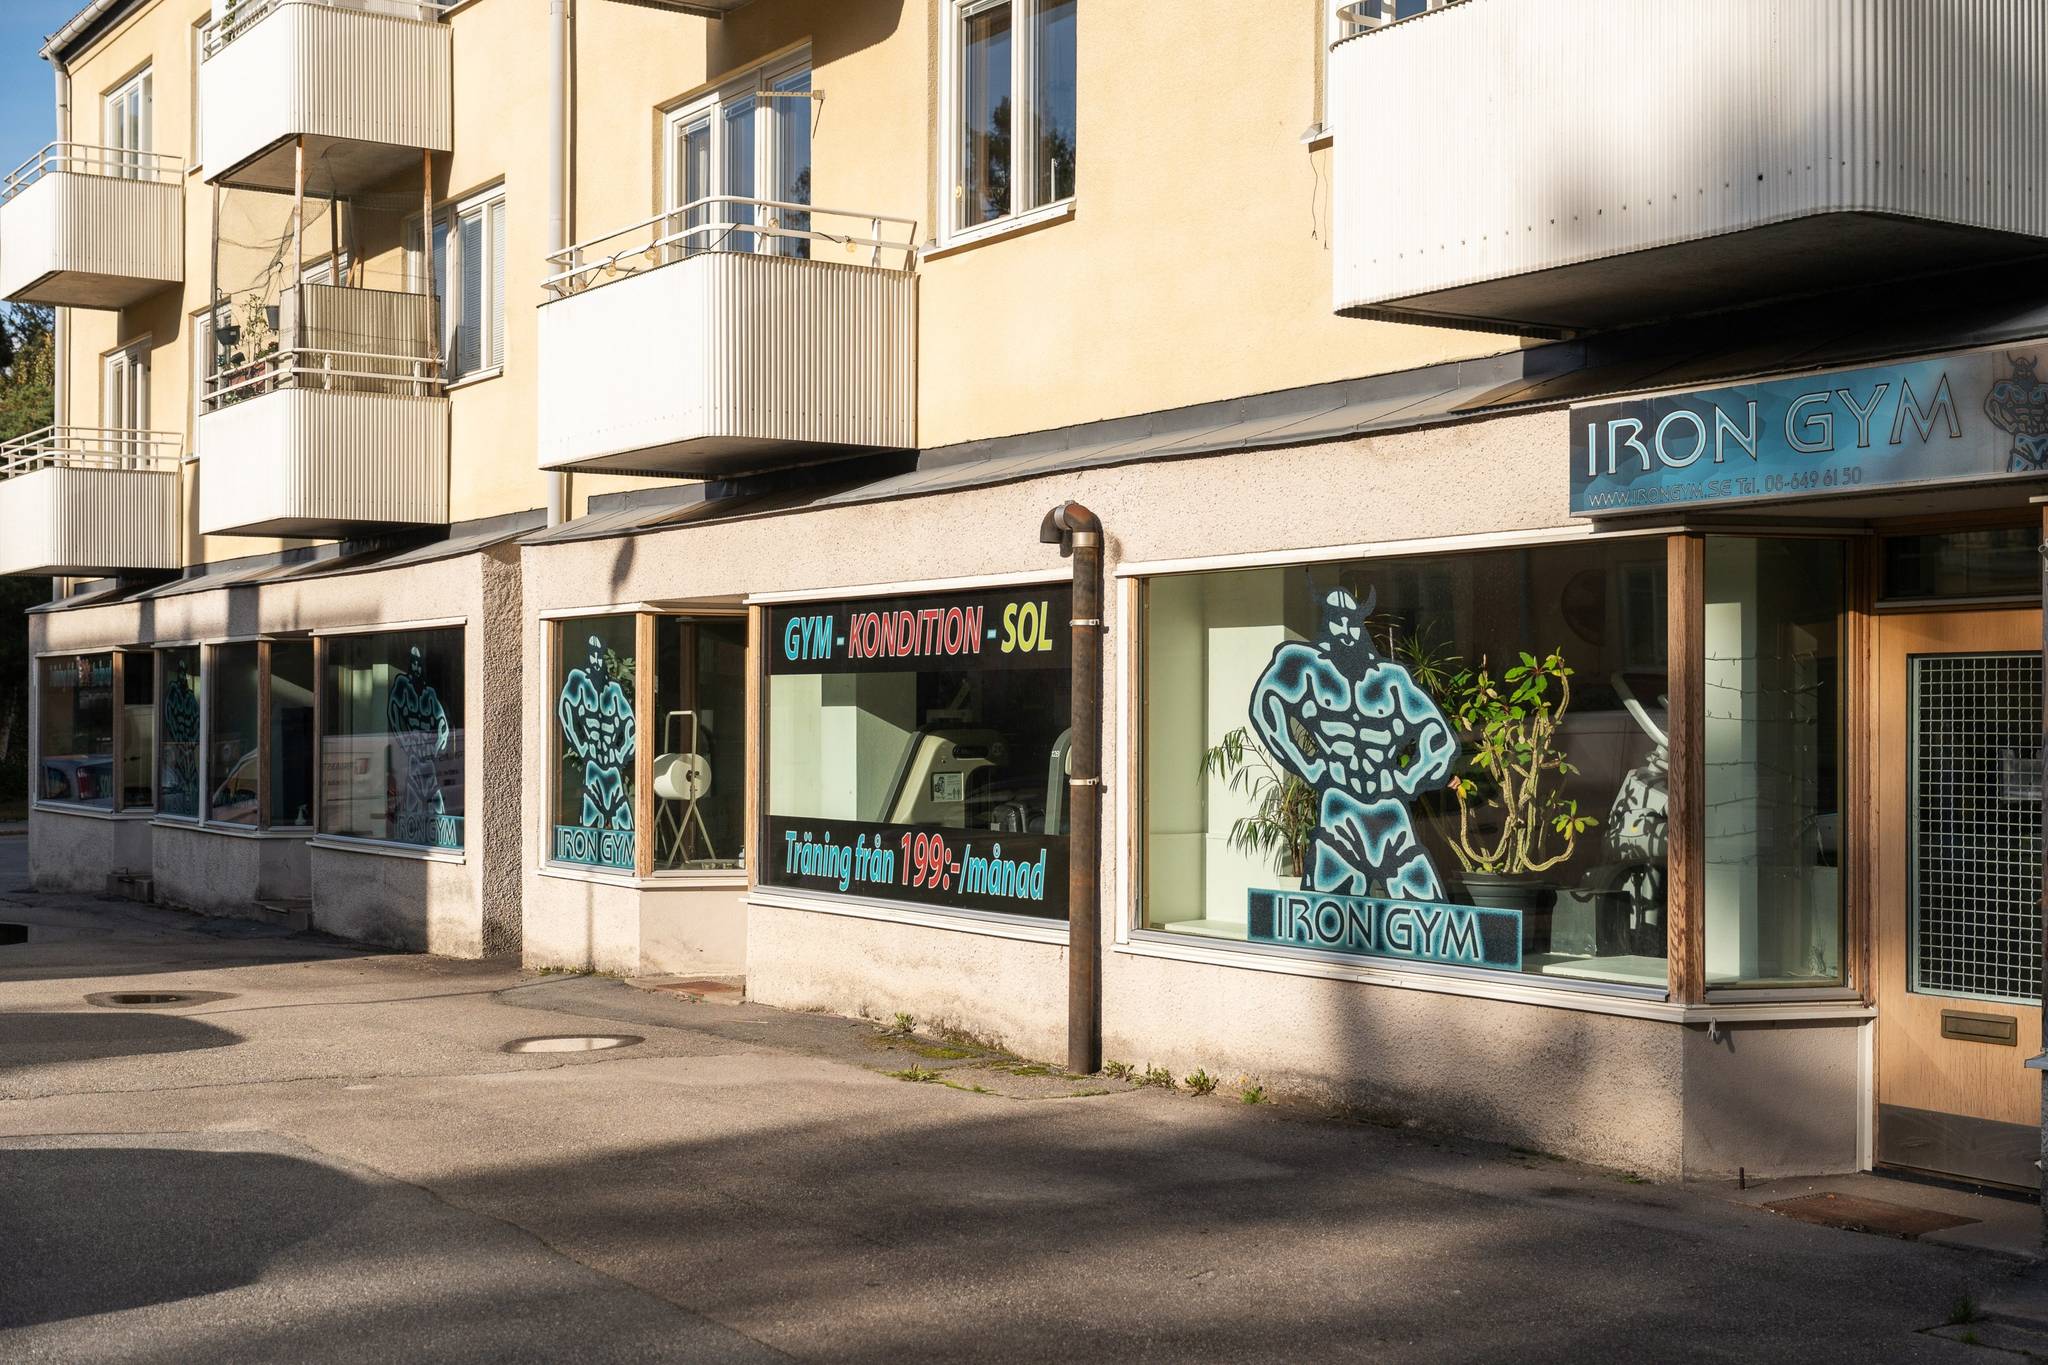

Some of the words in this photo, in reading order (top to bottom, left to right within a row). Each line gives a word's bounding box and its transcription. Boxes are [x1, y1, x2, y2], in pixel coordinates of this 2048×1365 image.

[1587, 399, 1758, 477] IRON
[1784, 372, 1963, 454] GYM
[1764, 470, 1819, 492] 08-649
[784, 615, 833, 661] GYM
[848, 605, 983, 659] KONDITION
[1000, 601, 1053, 653] SOL
[427, 816, 457, 846] GYM
[558, 827, 597, 861] IRON
[785, 830, 852, 892] Träning
[855, 833, 894, 884] från
[1277, 896, 1373, 947] IRON
[1385, 907, 1480, 958] GYM
